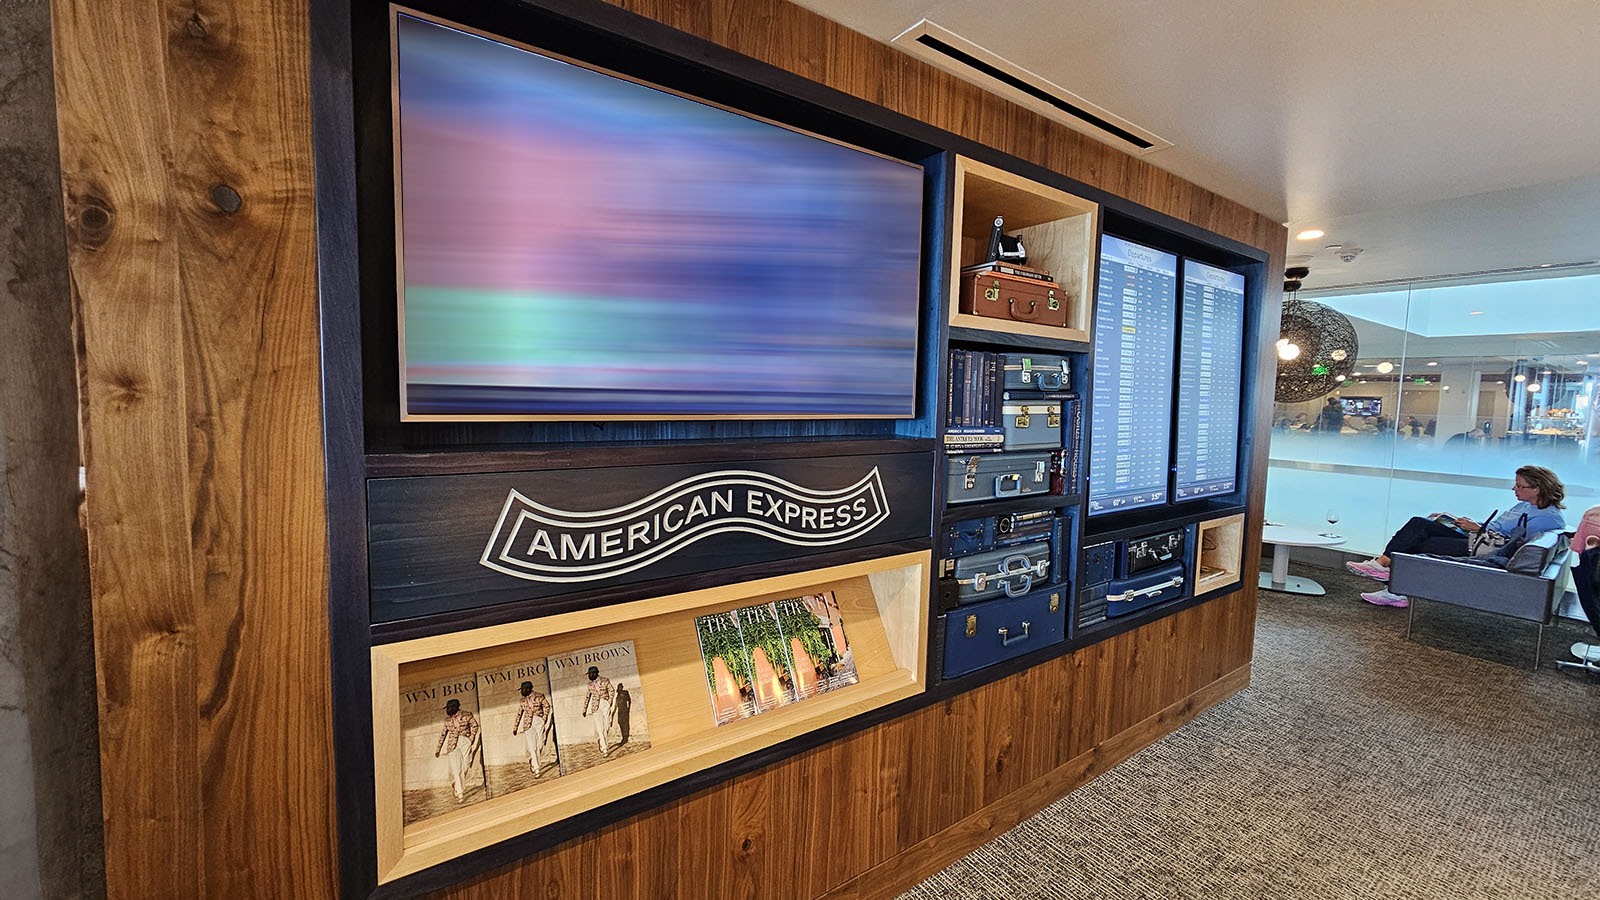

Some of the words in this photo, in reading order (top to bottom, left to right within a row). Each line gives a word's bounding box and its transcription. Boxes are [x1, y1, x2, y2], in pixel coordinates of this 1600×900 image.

[1127, 248, 1153, 263] Departures
[527, 489, 734, 561] AMERICAN
[746, 490, 869, 529] EXPRESS
[554, 655, 581, 670] WM
[583, 646, 633, 665] BROWN
[484, 670, 513, 686] WM
[517, 663, 546, 679] BRO
[405, 688, 436, 705] WM
[441, 679, 476, 698] BRO
